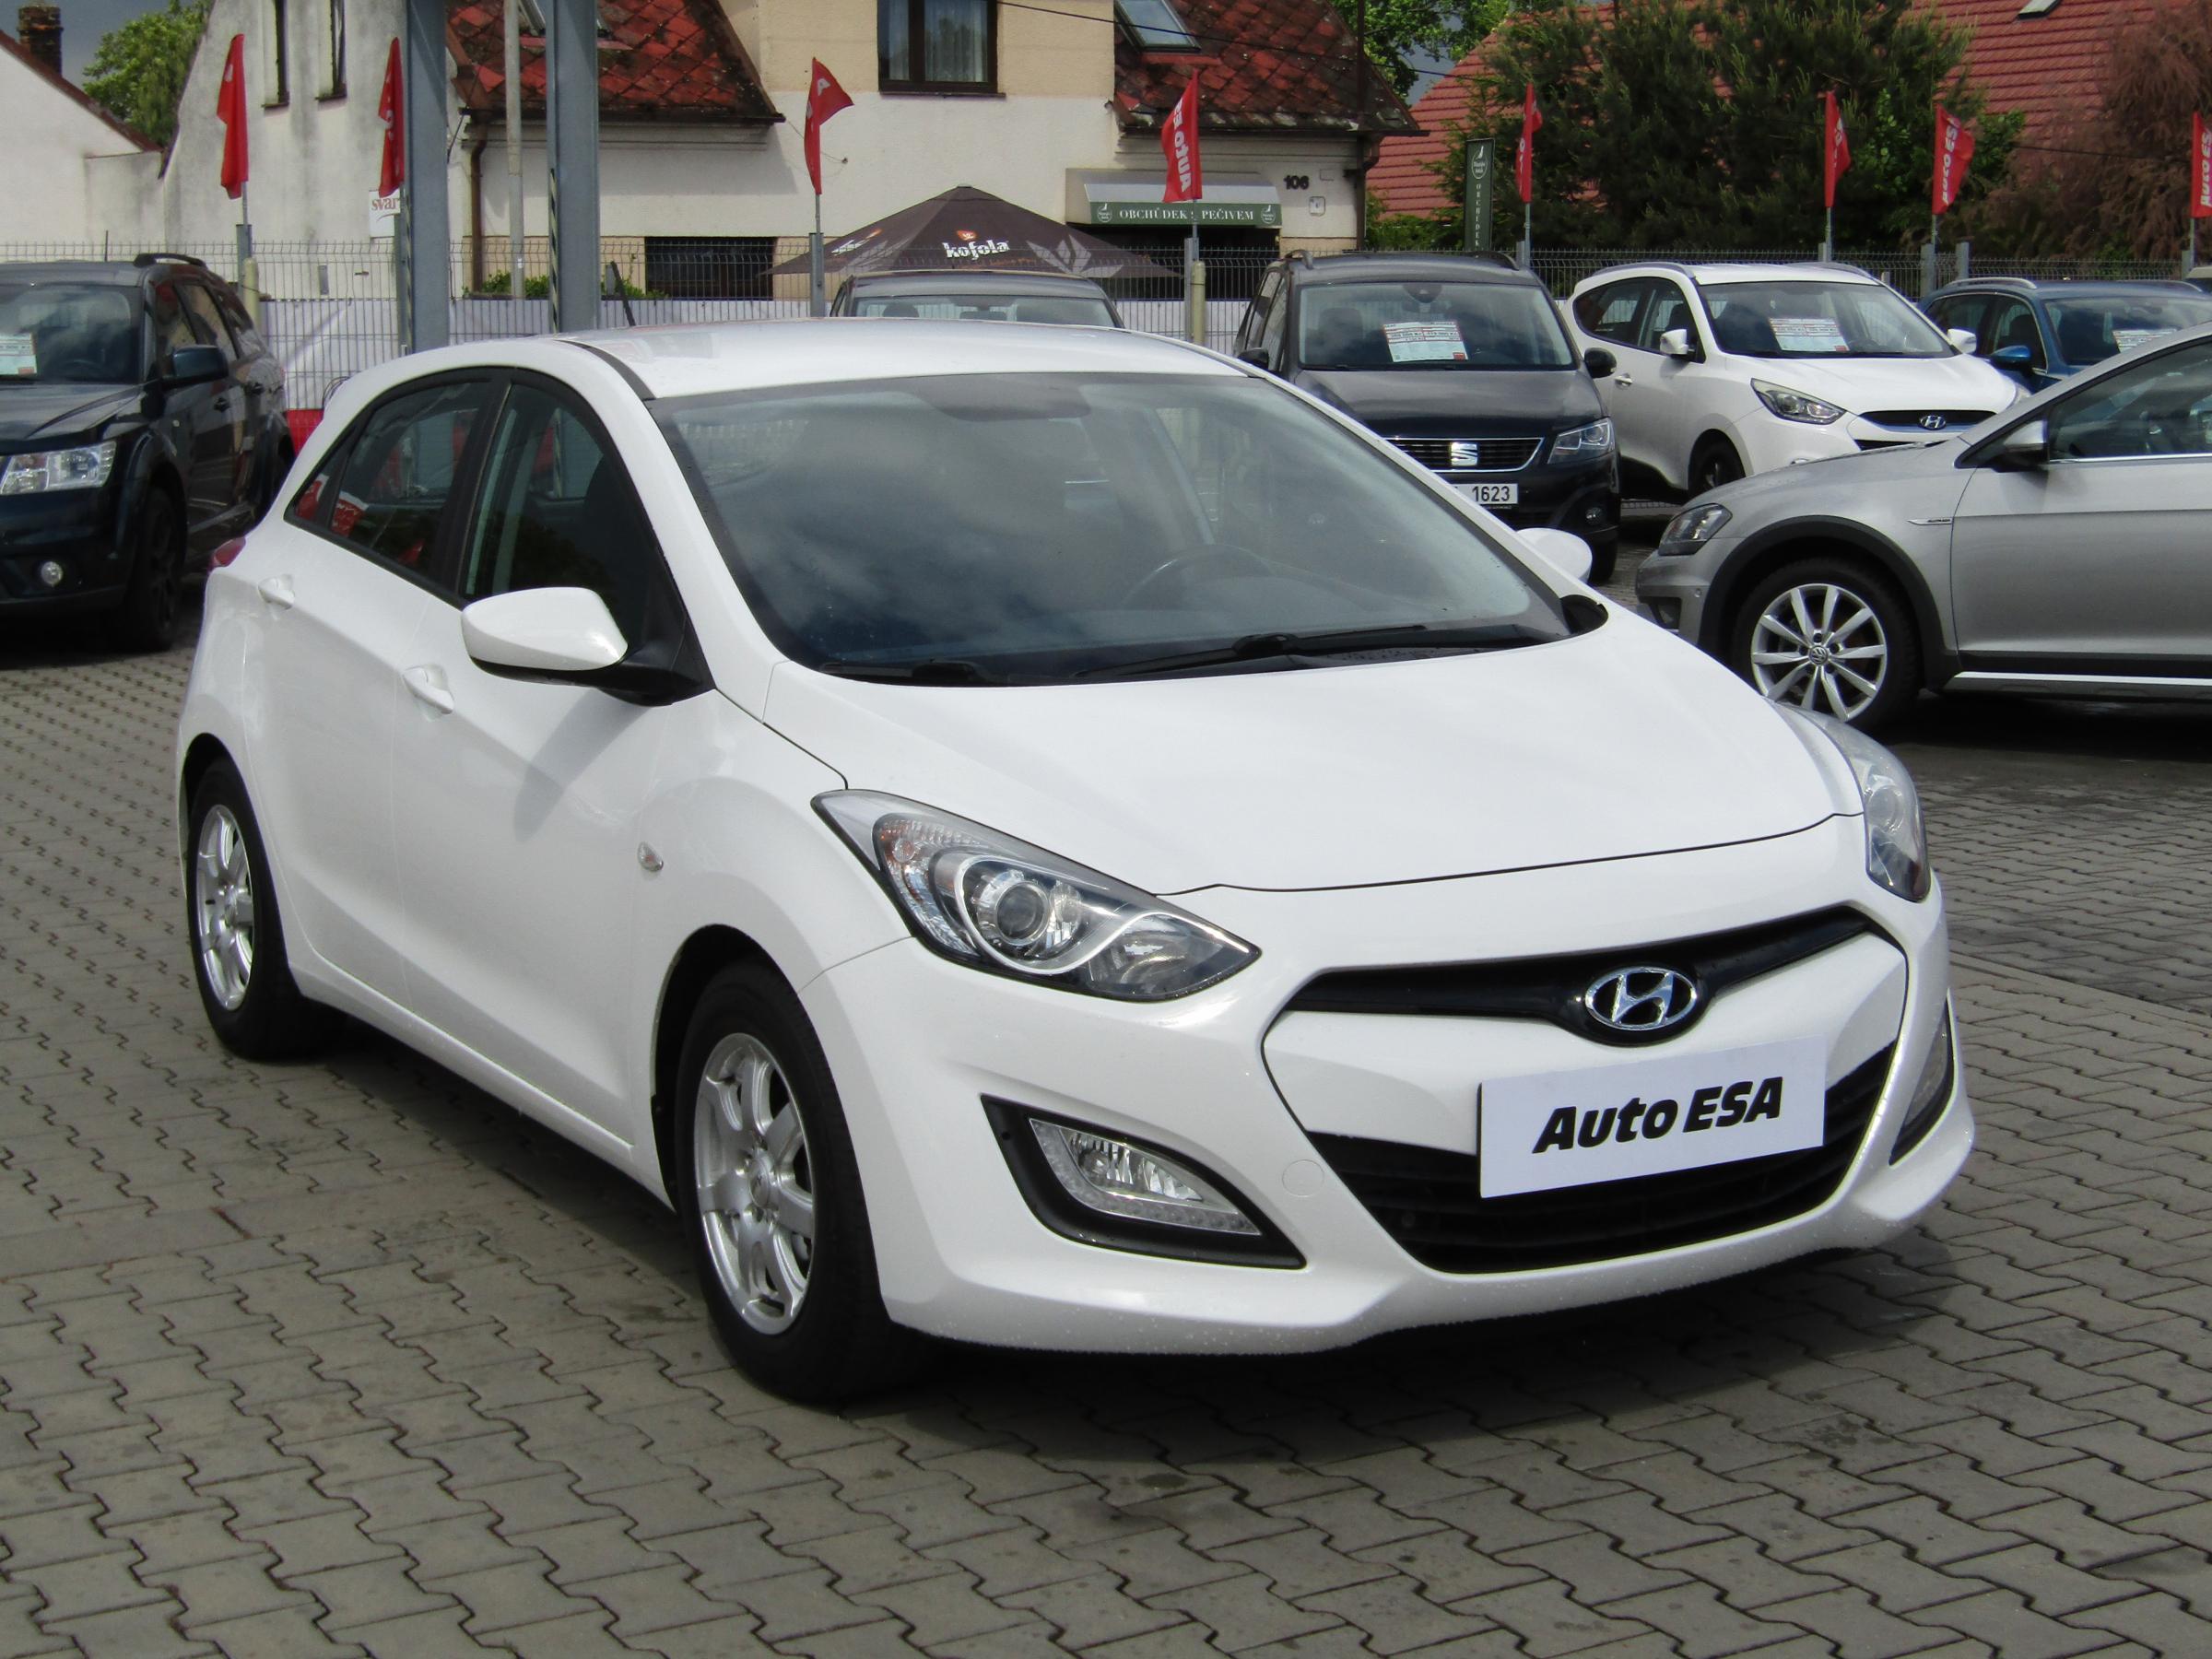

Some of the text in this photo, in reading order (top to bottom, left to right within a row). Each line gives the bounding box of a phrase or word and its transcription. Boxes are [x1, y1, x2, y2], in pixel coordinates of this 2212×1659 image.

[1283, 175, 1310, 190] 106
[1119, 207, 1188, 220] OBCHŮDEK
[1202, 207, 1254, 220] PEČIVEM
[942, 240, 1011, 261] kofola
[1472, 486, 1511, 502] 1623
[1532, 1077, 1783, 1154] Auto ESA
